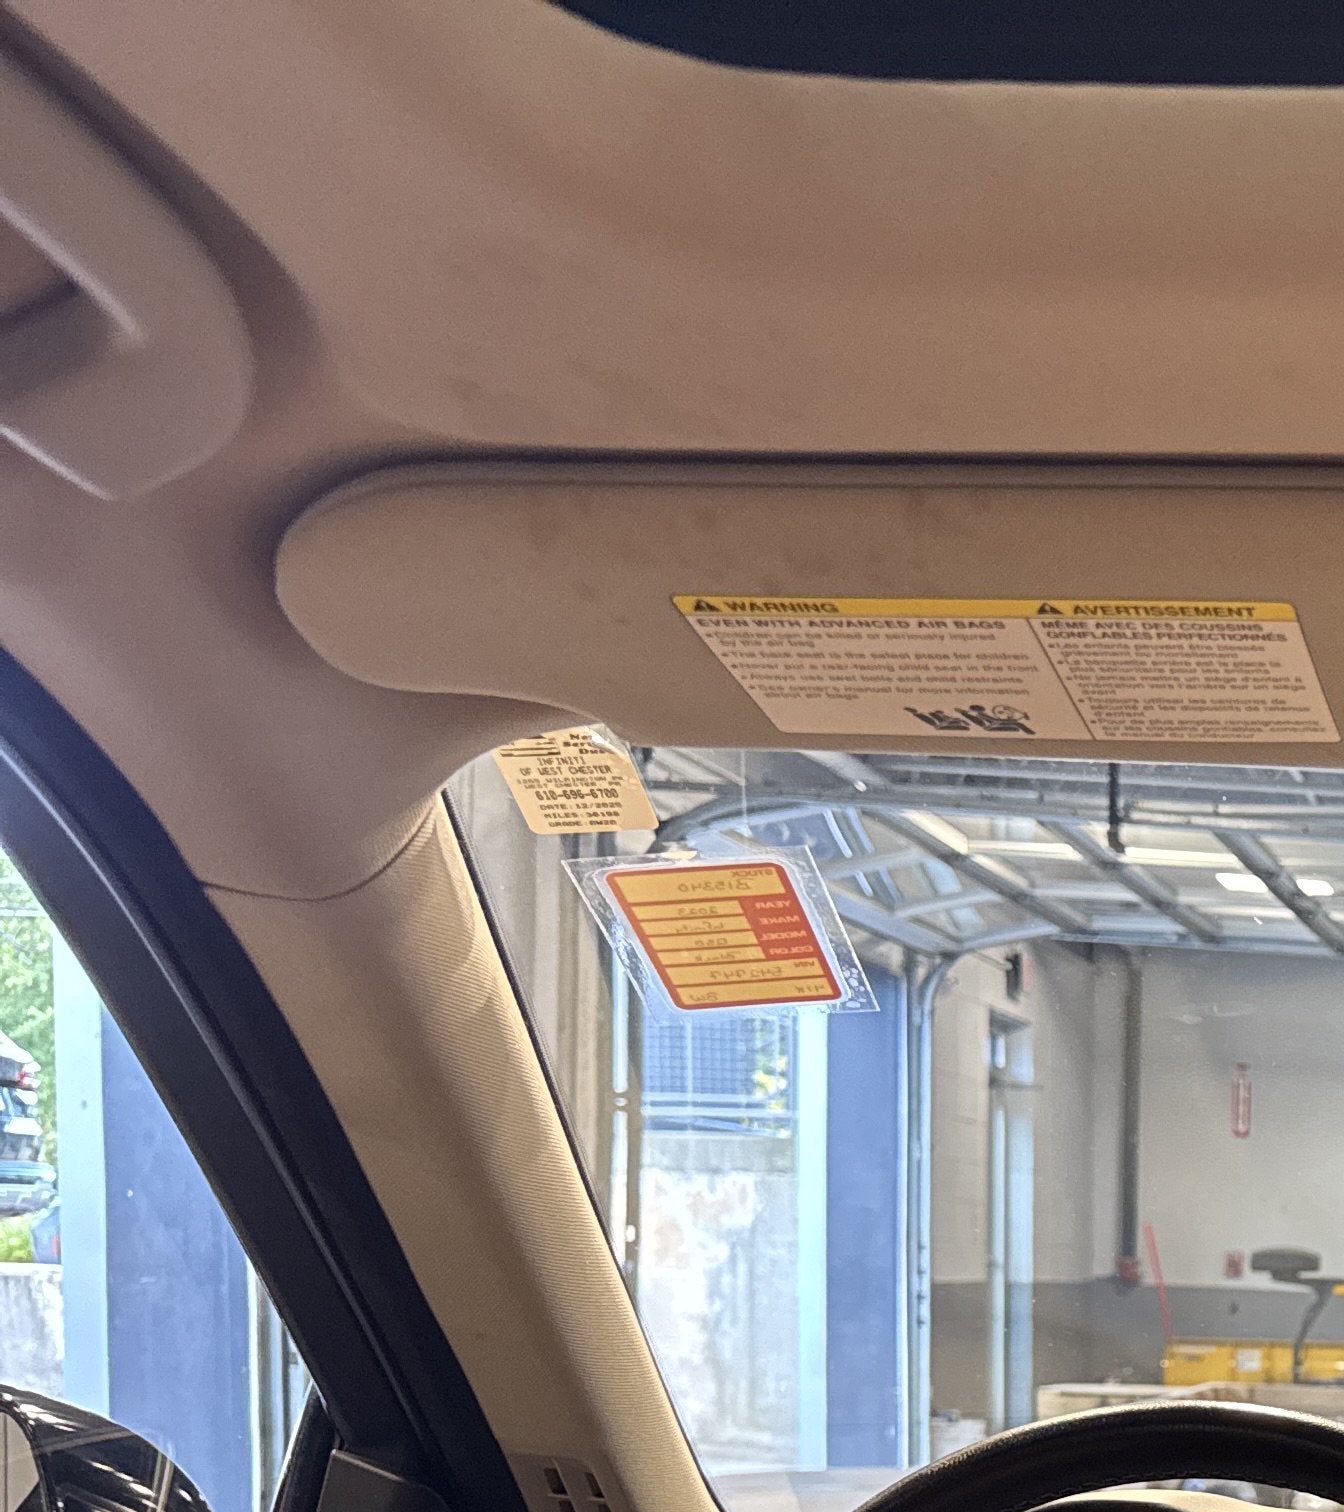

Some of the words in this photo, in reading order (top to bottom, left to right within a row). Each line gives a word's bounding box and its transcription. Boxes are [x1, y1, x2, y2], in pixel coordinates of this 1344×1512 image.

[723, 602, 839, 613] WARNING
[1073, 604, 1255, 617] AVERTISSEMENT
[696, 619, 749, 628] EVEN
[752, 619, 802, 628] WITH
[808, 620, 911, 629] ADVANCED
[918, 621, 949, 629] AIR
[953, 621, 1006, 629] BAGS
[1095, 622, 1138, 630] AVEC
[1179, 623, 1263, 631] COUSSINS
[537, 756, 587, 766] INFINITI
[520, 767, 532, 777] OF
[537, 766, 563, 776] WEST
[568, 764, 613, 775] CHESTER
[535, 788, 620, 801] 610-696-6700
